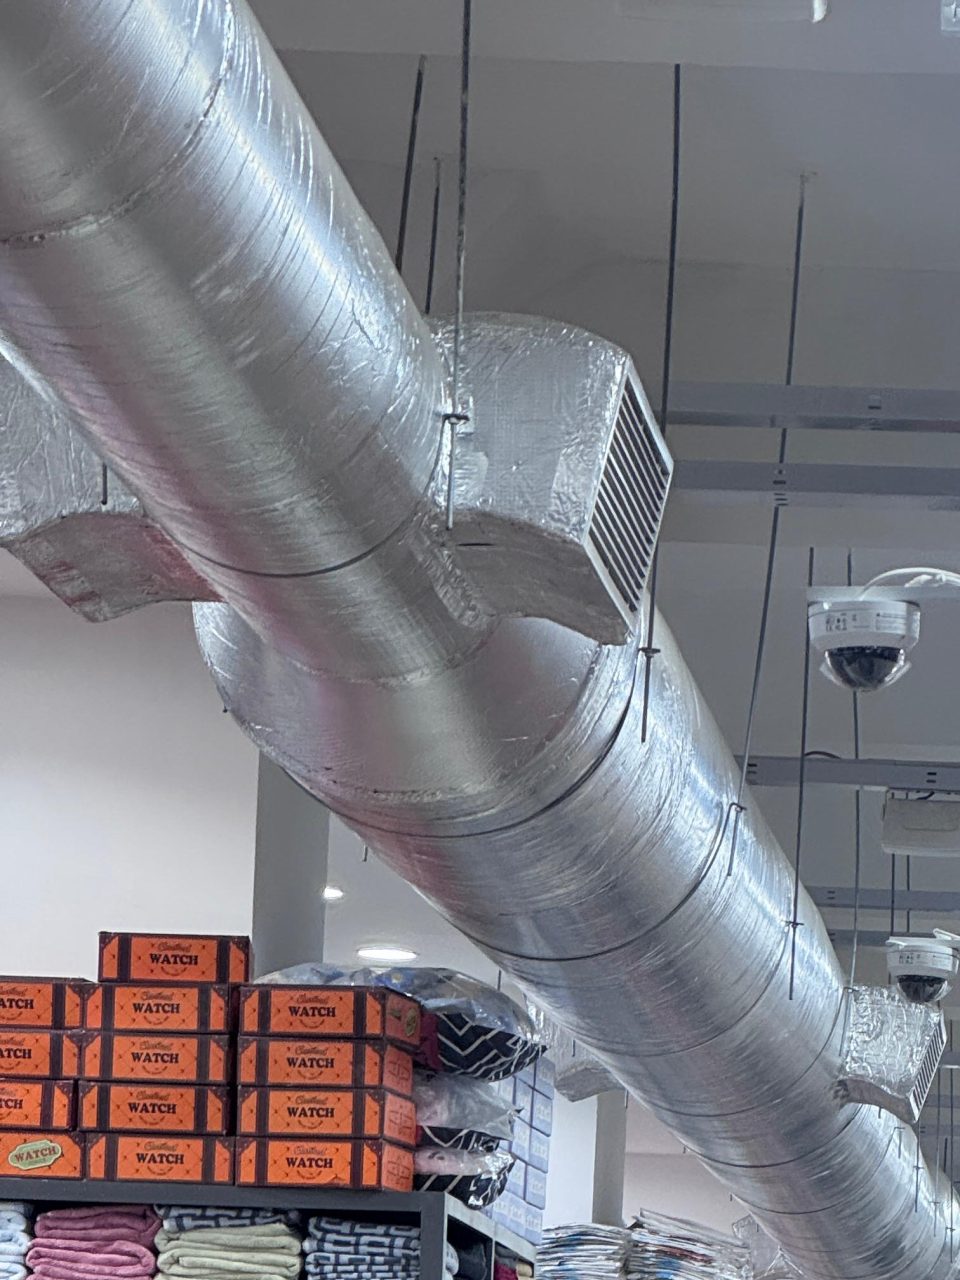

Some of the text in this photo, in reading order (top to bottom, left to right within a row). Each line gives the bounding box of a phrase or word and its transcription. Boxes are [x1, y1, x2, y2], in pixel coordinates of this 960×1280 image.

[149, 953, 199, 966] WATCH
[132, 1002, 181, 1014] WATCH
[288, 1005, 336, 1018] WATCH
[130, 1051, 180, 1064] WATCH
[286, 1057, 335, 1069] WATCH
[127, 1102, 177, 1115] WATCH
[286, 1106, 335, 1118] WATCH
[15, 1147, 56, 1163] WATCH
[135, 1152, 185, 1165] WATCH
[285, 1157, 333, 1169] WATCH
